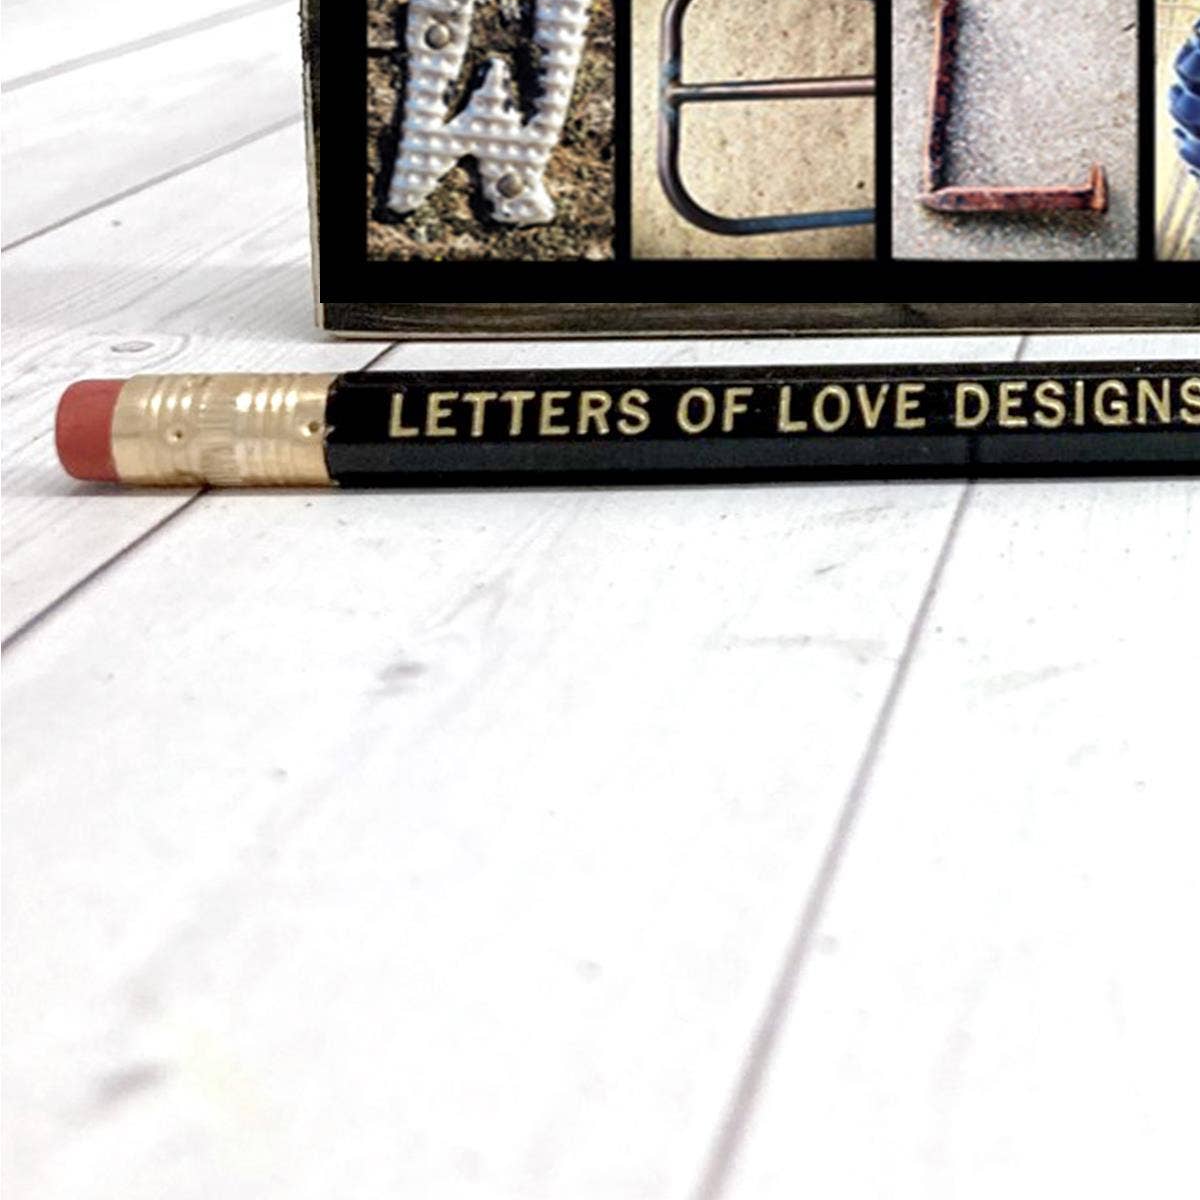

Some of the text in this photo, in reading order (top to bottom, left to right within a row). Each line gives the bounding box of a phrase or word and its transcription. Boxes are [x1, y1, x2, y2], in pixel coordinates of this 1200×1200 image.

[389, 389, 651, 437] LETTERS
[676, 387, 753, 434] OF
[778, 383, 926, 432] LOVE
